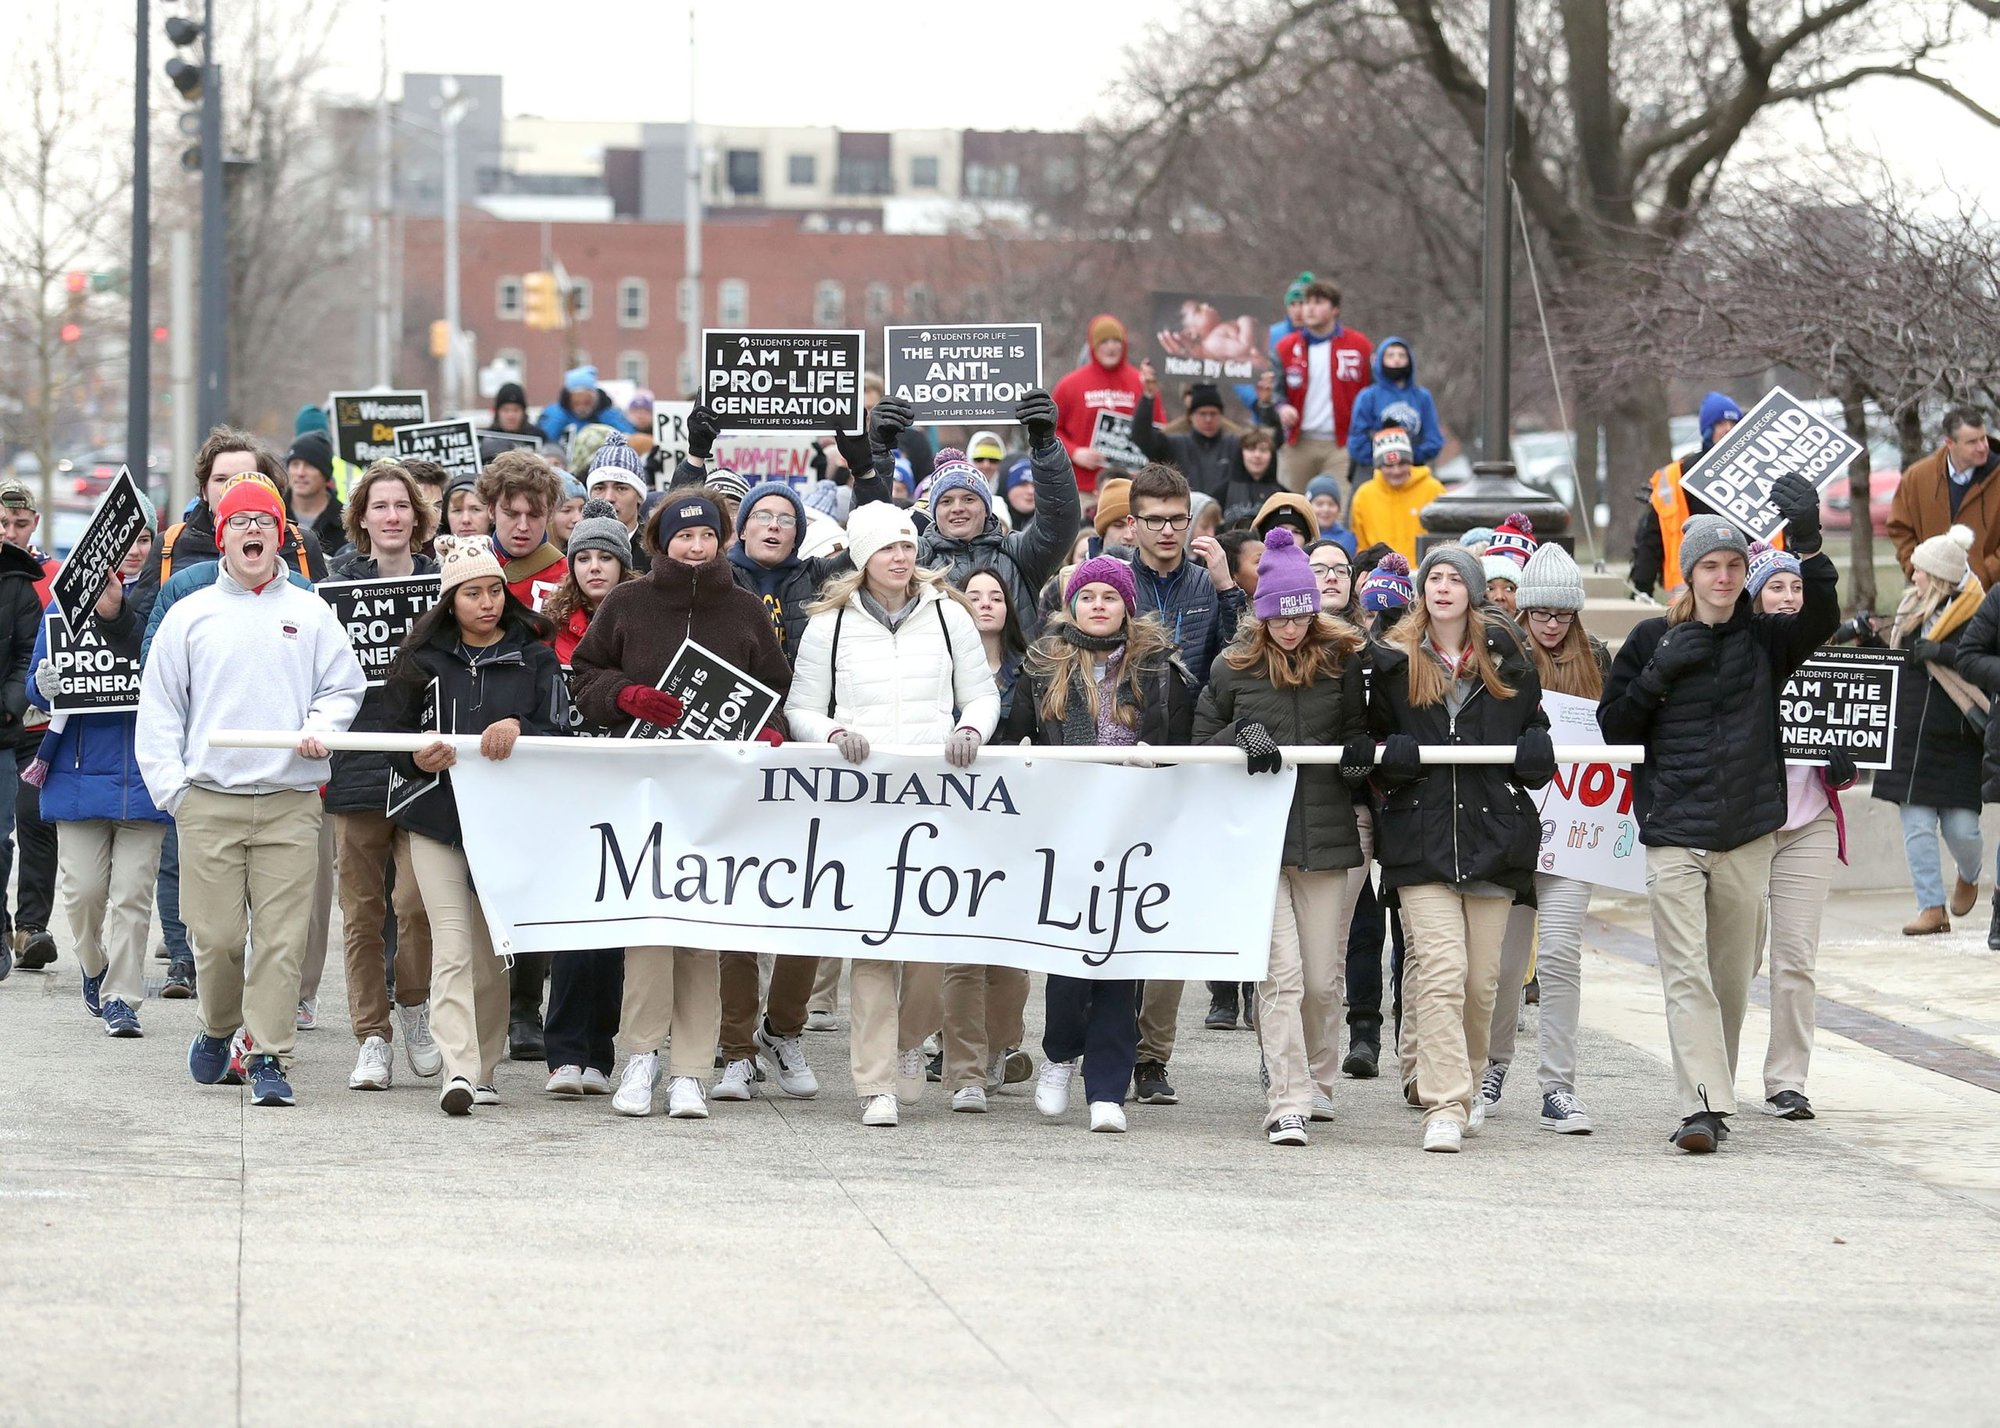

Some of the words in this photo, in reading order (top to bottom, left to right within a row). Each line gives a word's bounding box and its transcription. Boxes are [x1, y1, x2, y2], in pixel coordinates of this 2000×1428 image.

[751, 339, 791, 347] STUDENTS
[793, 339, 810, 347] FOR
[811, 339, 828, 347] LIFE
[932, 333, 971, 341] STUDENTS
[973, 332, 990, 340] FOR
[991, 332, 1007, 340] LIFE
[717, 349, 724, 366] I
[737, 349, 780, 366] AM
[793, 349, 847, 367] THE
[901, 347, 933, 360] THE
[939, 346, 1003, 360] FUTURE
[1009, 345, 1025, 359] IS
[925, 361, 1001, 381] ANTI-
[1165, 356, 1202, 376] Made
[1223, 359, 1252, 379] God
[709, 369, 855, 394] PRO-LIFE
[895, 382, 1033, 403] ABORTION
[358, 401, 423, 420] Women
[711, 396, 851, 415] GENERATION
[413, 435, 436, 451] AM
[439, 432, 469, 448] THE
[1704, 408, 1809, 506] DEFUND
[1726, 425, 1830, 521] PLANNED
[75, 526, 97, 559] STUDENTS
[95, 512, 105, 528] FOR
[103, 499, 113, 516] LIFE
[64, 564, 83, 593] THE
[82, 509, 116, 565] FUTURE
[117, 493, 127, 509] IS
[82, 524, 118, 588] ANTI-
[71, 507, 141, 626] ABORTION
[363, 586, 405, 597] STUDENTS
[406, 585, 423, 593] FOR
[425, 584, 441, 592] LIFE
[352, 598, 395, 618] AM
[60, 632, 67, 648] I
[370, 668, 386, 676] TEXT
[693, 668, 709, 686] IS
[1795, 669, 1832, 679] STUDENTS
[1833, 671, 1849, 680] FOR
[1850, 672, 1865, 680] LIFE
[668, 674, 682, 692] LIFE
[1781, 680, 1821, 698] AM
[1833, 682, 1881, 701] THE
[95, 695, 110, 703] TEXT
[111, 694, 125, 702] LIFE
[758, 767, 1020, 816] INDIANA
[1567, 820, 1604, 849] it's
[1613, 820, 1635, 858] a
[590, 817, 853, 910] March
[860, 822, 1006, 946] for
[1034, 842, 1171, 967] Life
